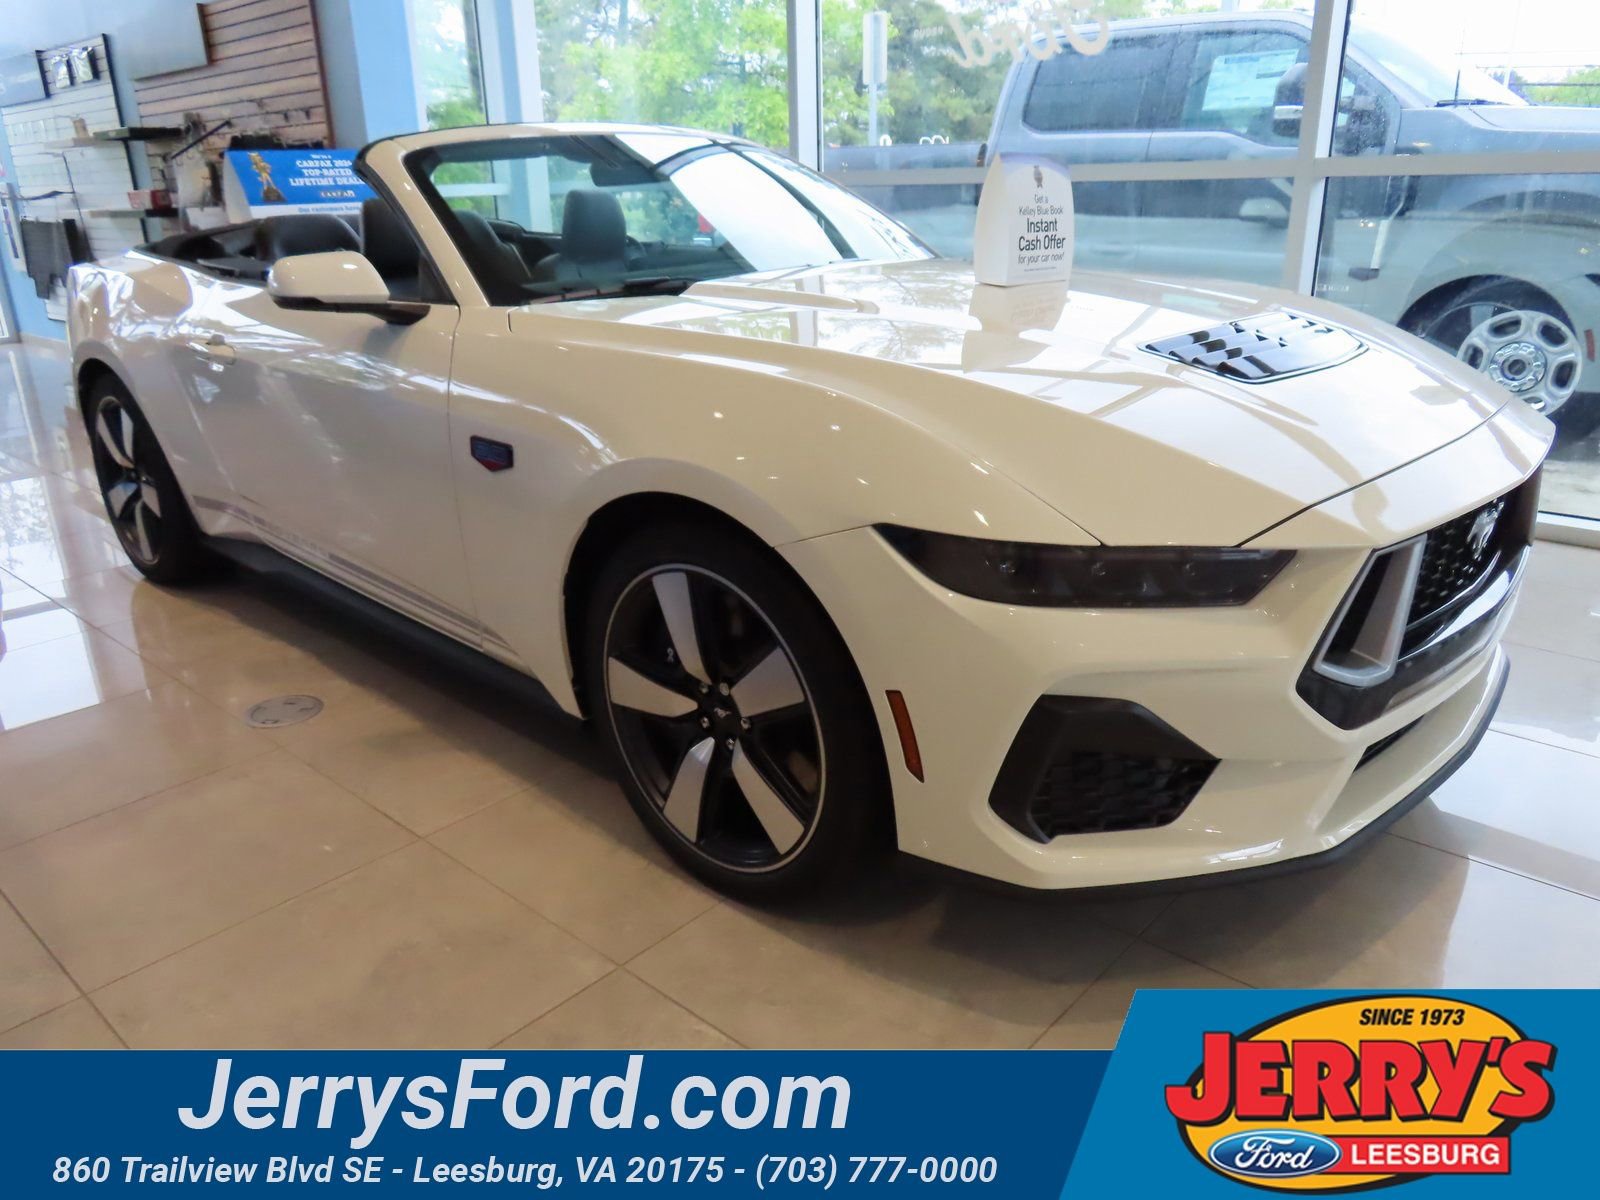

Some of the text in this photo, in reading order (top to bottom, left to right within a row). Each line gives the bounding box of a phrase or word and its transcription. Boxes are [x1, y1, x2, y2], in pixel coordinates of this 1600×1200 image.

[289, 178, 334, 186] LIFETIME
[1034, 194, 1045, 204] Get
[1019, 205, 1064, 217] Kelley Blue Book
[1027, 218, 1058, 233] Instant
[1018, 234, 1066, 251] Cash Offer
[1018, 254, 1026, 265] for
[1027, 255, 1041, 266] your
[1041, 253, 1050, 263] car
